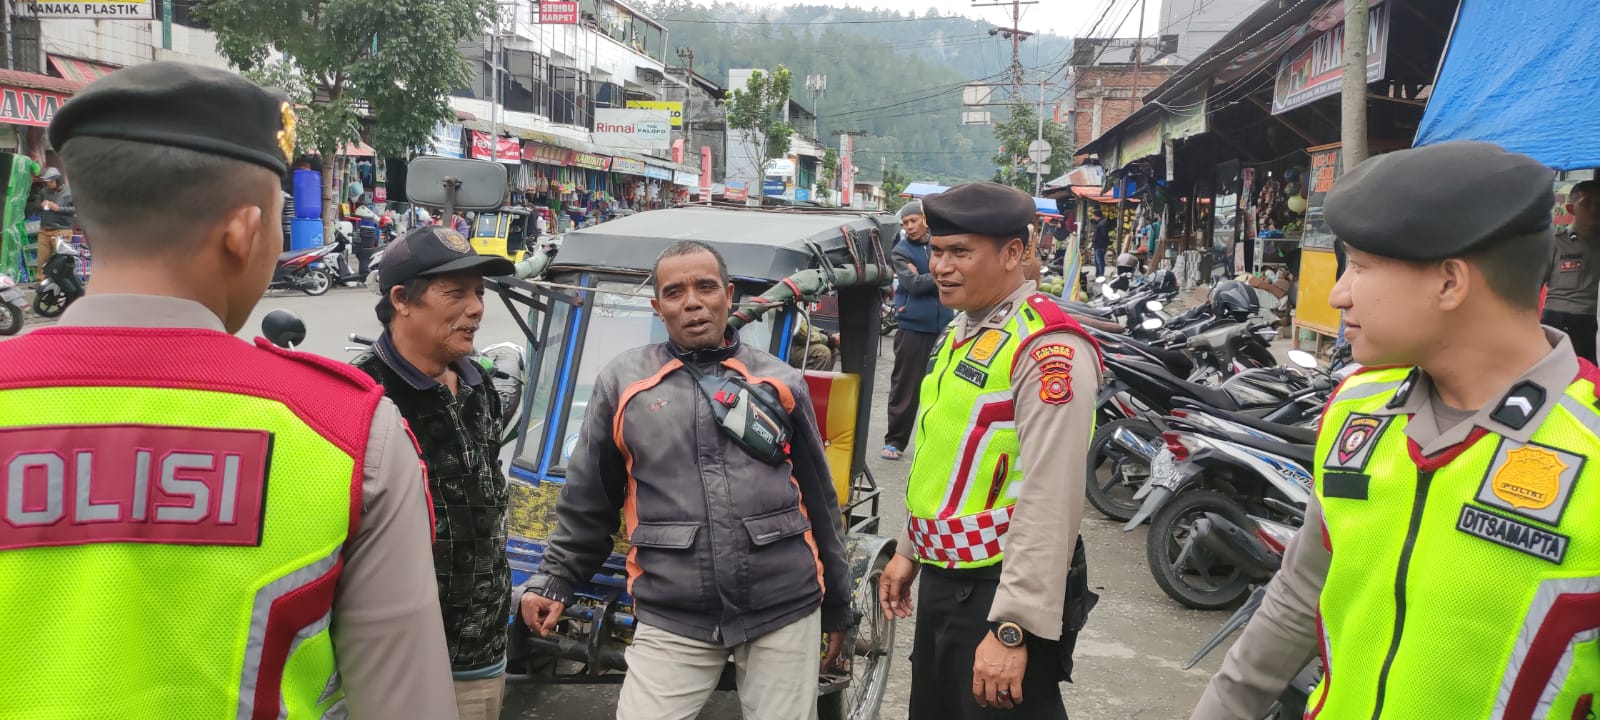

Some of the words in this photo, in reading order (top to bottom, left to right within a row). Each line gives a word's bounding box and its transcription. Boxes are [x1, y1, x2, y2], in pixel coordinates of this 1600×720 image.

[27, 3, 80, 14] KANAKA
[85, 4, 139, 15] PLASTIK
[542, 4, 574, 12] SERIBU
[542, 14, 574, 22] KARPET
[1312, 7, 1381, 78] WAKN
[0, 89, 73, 123] ANA
[596, 122, 635, 134] Rinnai
[1502, 482, 1544, 499] POLISI
[1463, 509, 1560, 558] DITSAMAPTA
